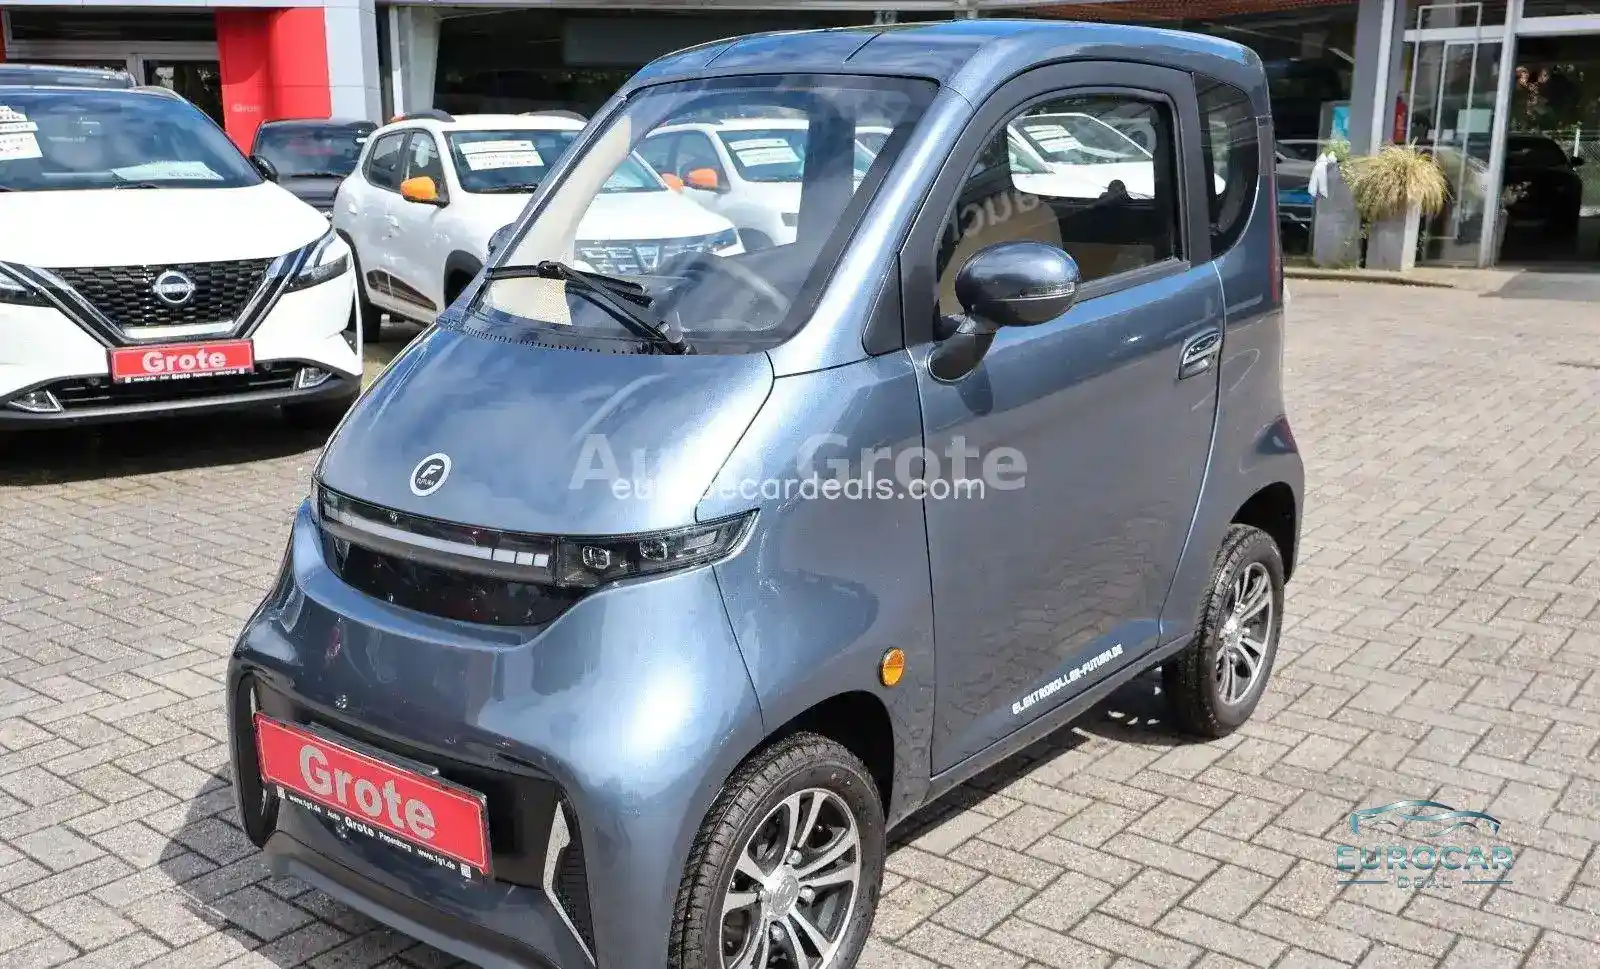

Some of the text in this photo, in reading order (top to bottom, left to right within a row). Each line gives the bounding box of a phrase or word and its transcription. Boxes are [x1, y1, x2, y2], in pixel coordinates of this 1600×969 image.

[141, 348, 227, 373] Grote
[299, 744, 436, 840] Grote
[345, 816, 375, 837] Grote
